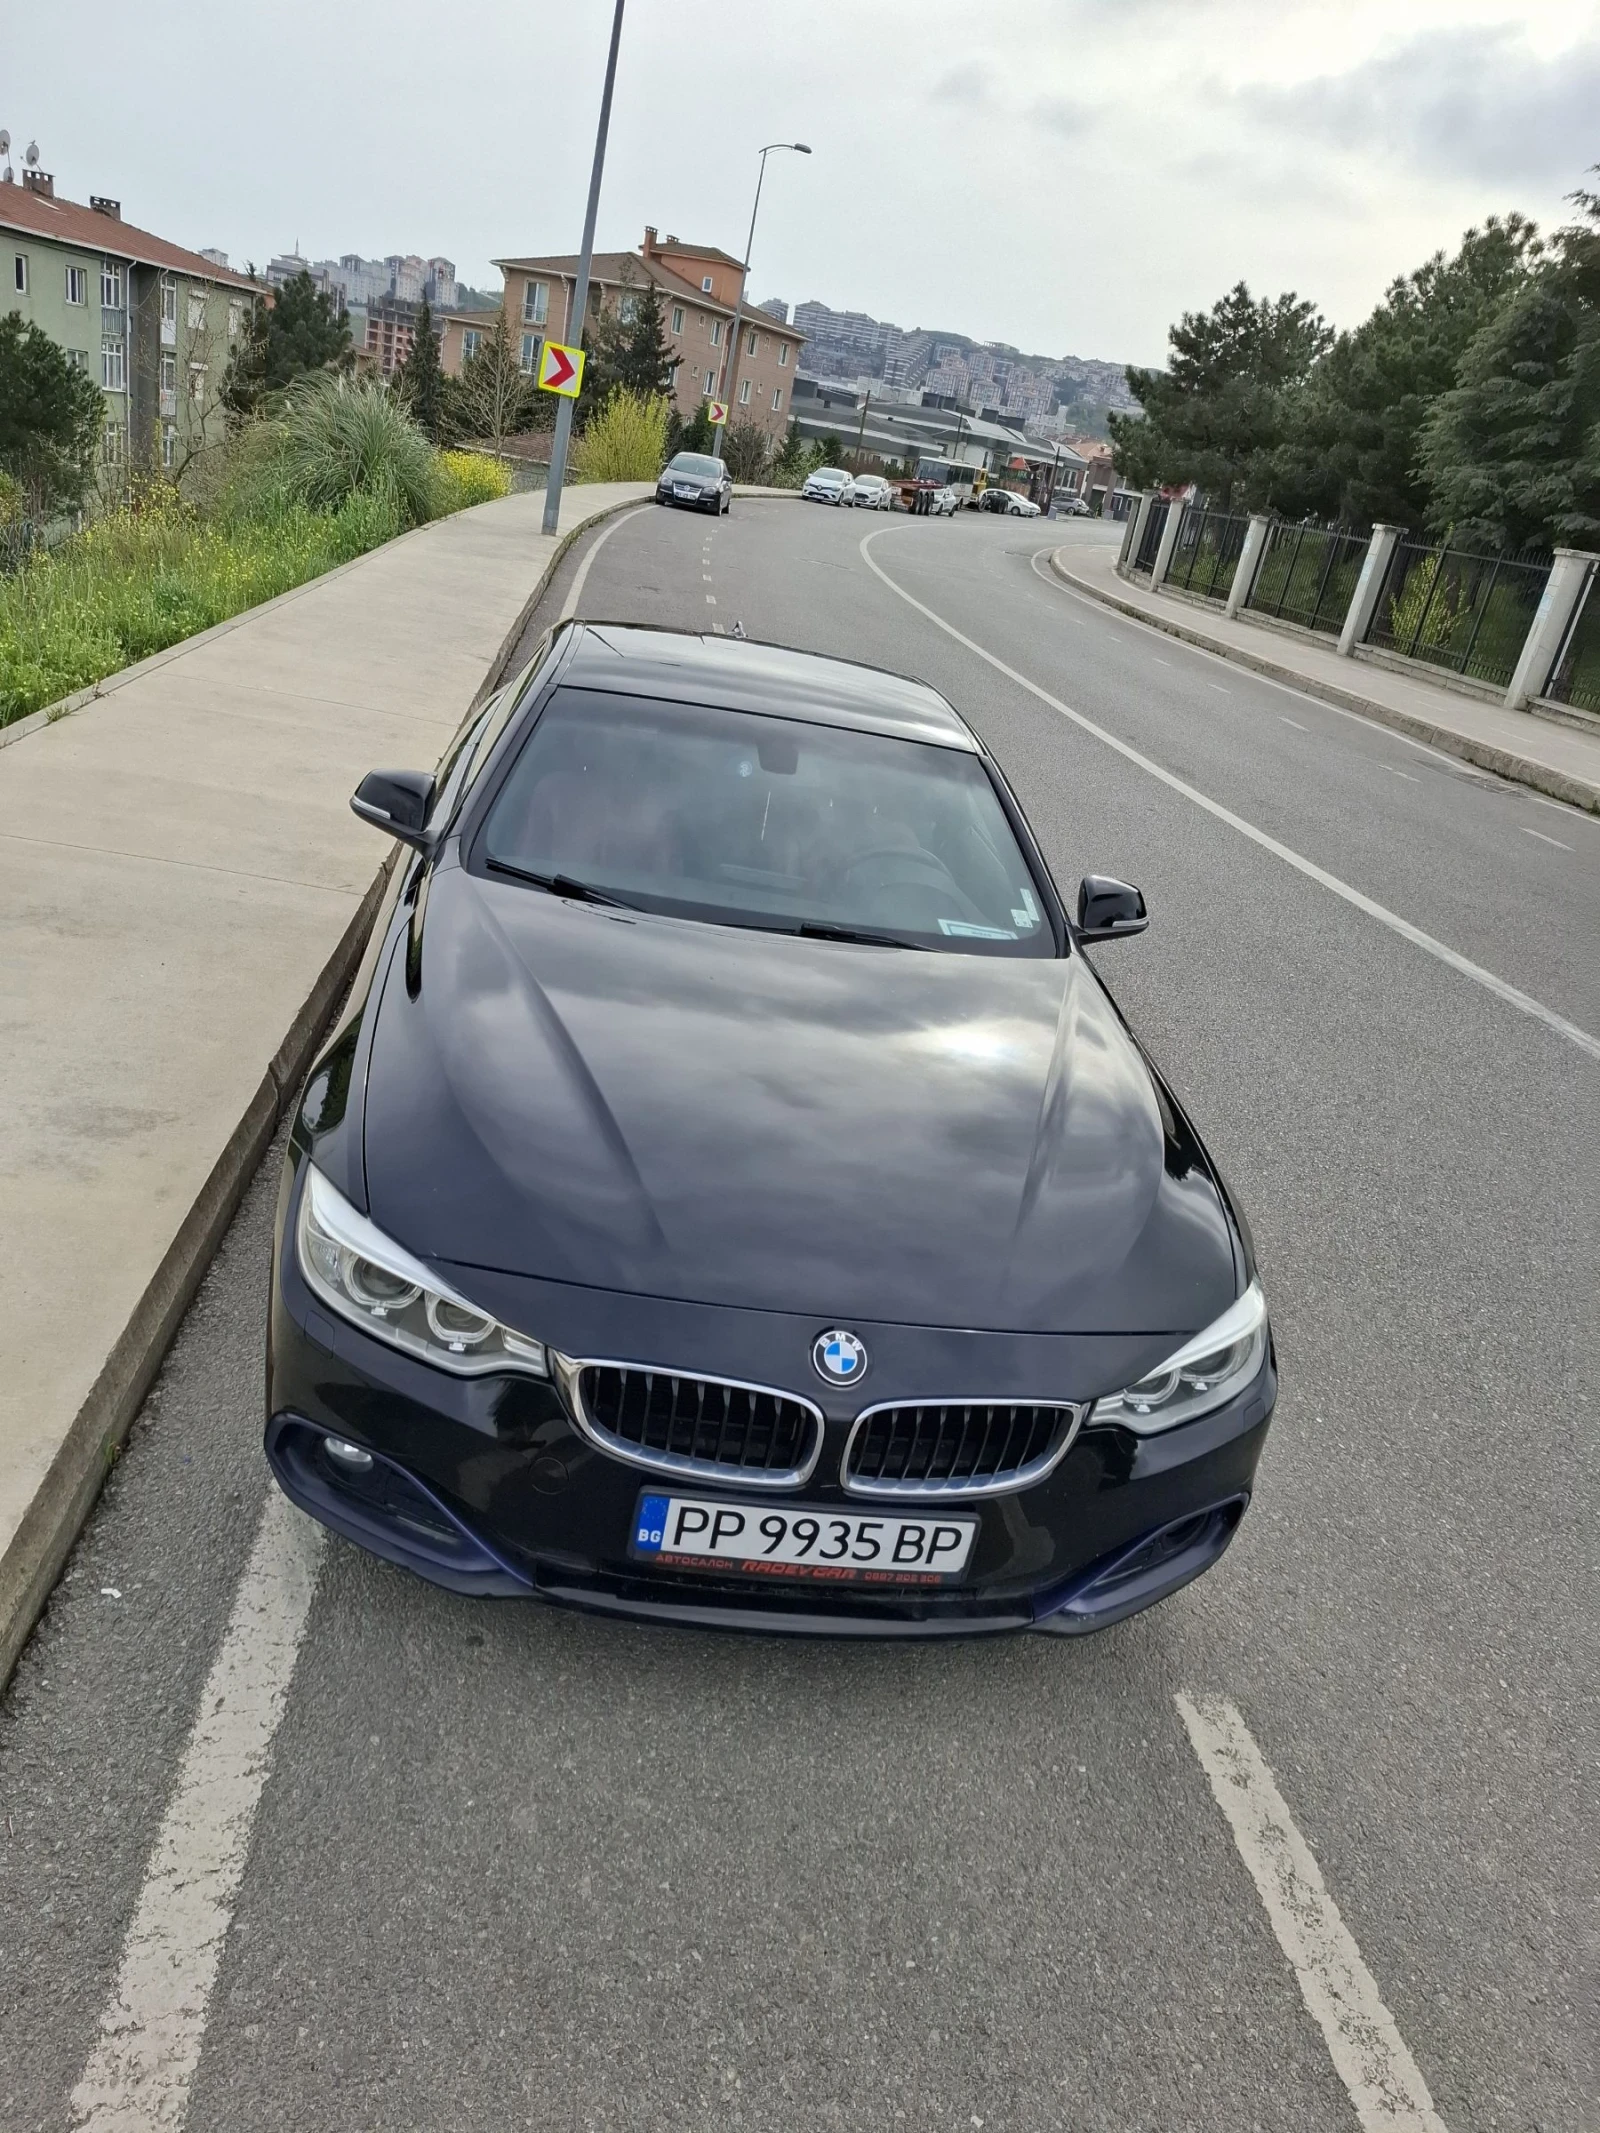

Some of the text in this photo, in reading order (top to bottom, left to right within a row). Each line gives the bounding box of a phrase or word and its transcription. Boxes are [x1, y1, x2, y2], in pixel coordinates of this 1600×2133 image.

[819, 1333, 863, 1351] BMW
[638, 1528, 661, 1543] BG
[673, 1506, 962, 1565] PP 9935 BP
